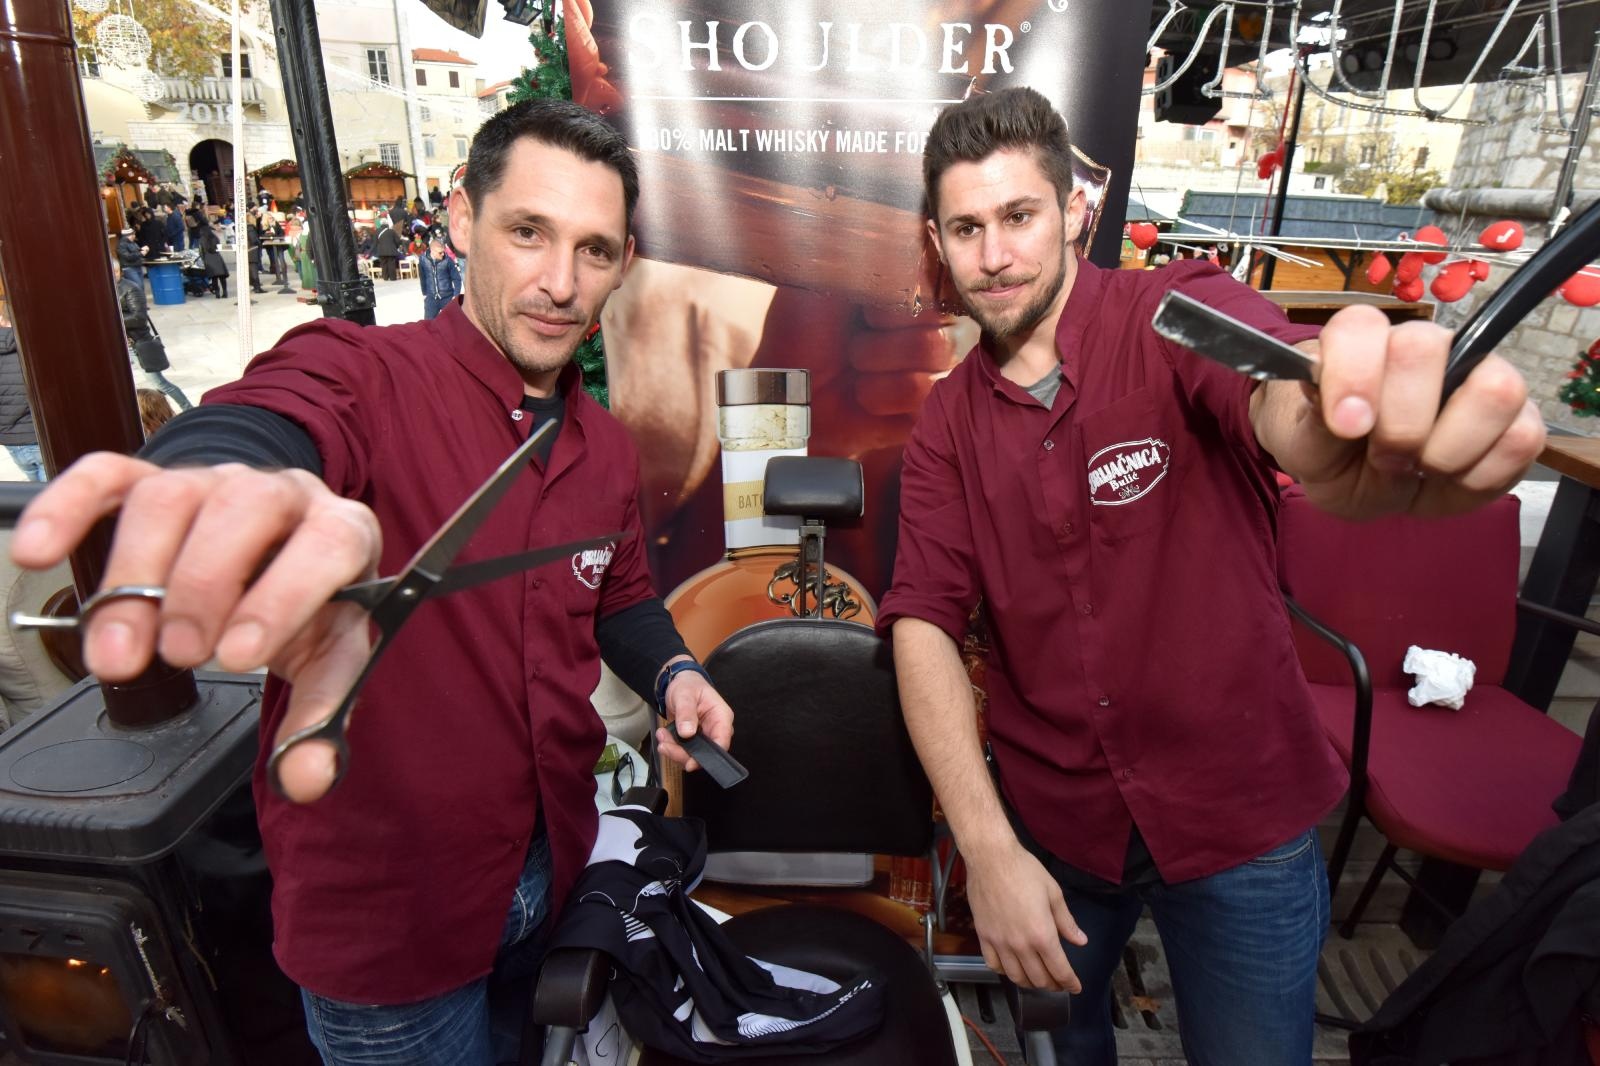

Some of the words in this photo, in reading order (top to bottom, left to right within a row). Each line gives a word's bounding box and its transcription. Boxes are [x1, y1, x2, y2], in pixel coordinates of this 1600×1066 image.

[628, 12, 1014, 74] SHOULDER
[636, 128, 692, 151] 00%
[699, 128, 750, 152] MALT
[755, 129, 830, 152] WHISKY
[836, 129, 888, 153] MADE
